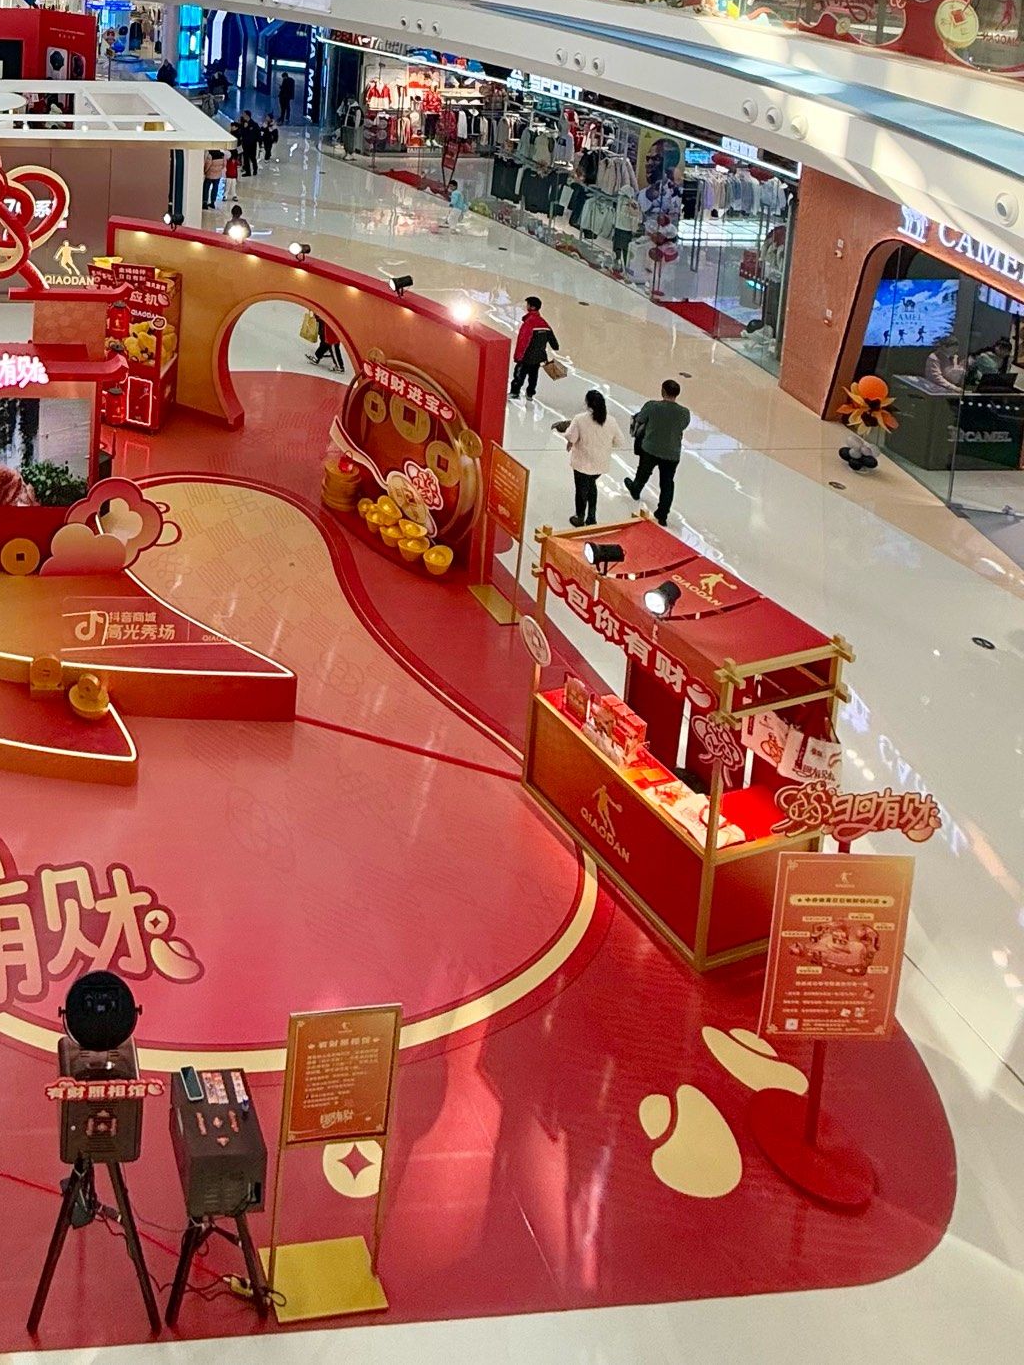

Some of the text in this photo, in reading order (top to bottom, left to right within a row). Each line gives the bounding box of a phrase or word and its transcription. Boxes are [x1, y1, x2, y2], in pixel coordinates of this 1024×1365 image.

[529, 73, 583, 101] SPORT
[44, 275, 95, 286] QIAODAN
[373, 366, 441, 417] 招财进宝
[965, 431, 1012, 442] CAMEL
[671, 572, 725, 608] QIAODAN
[109, 611, 157, 623] 抖音商城
[107, 623, 175, 640] 高光秀场
[565, 578, 689, 694] 包你有财
[579, 806, 632, 863] QIAODAN
[47, 1081, 147, 1100] 有财照相馆
